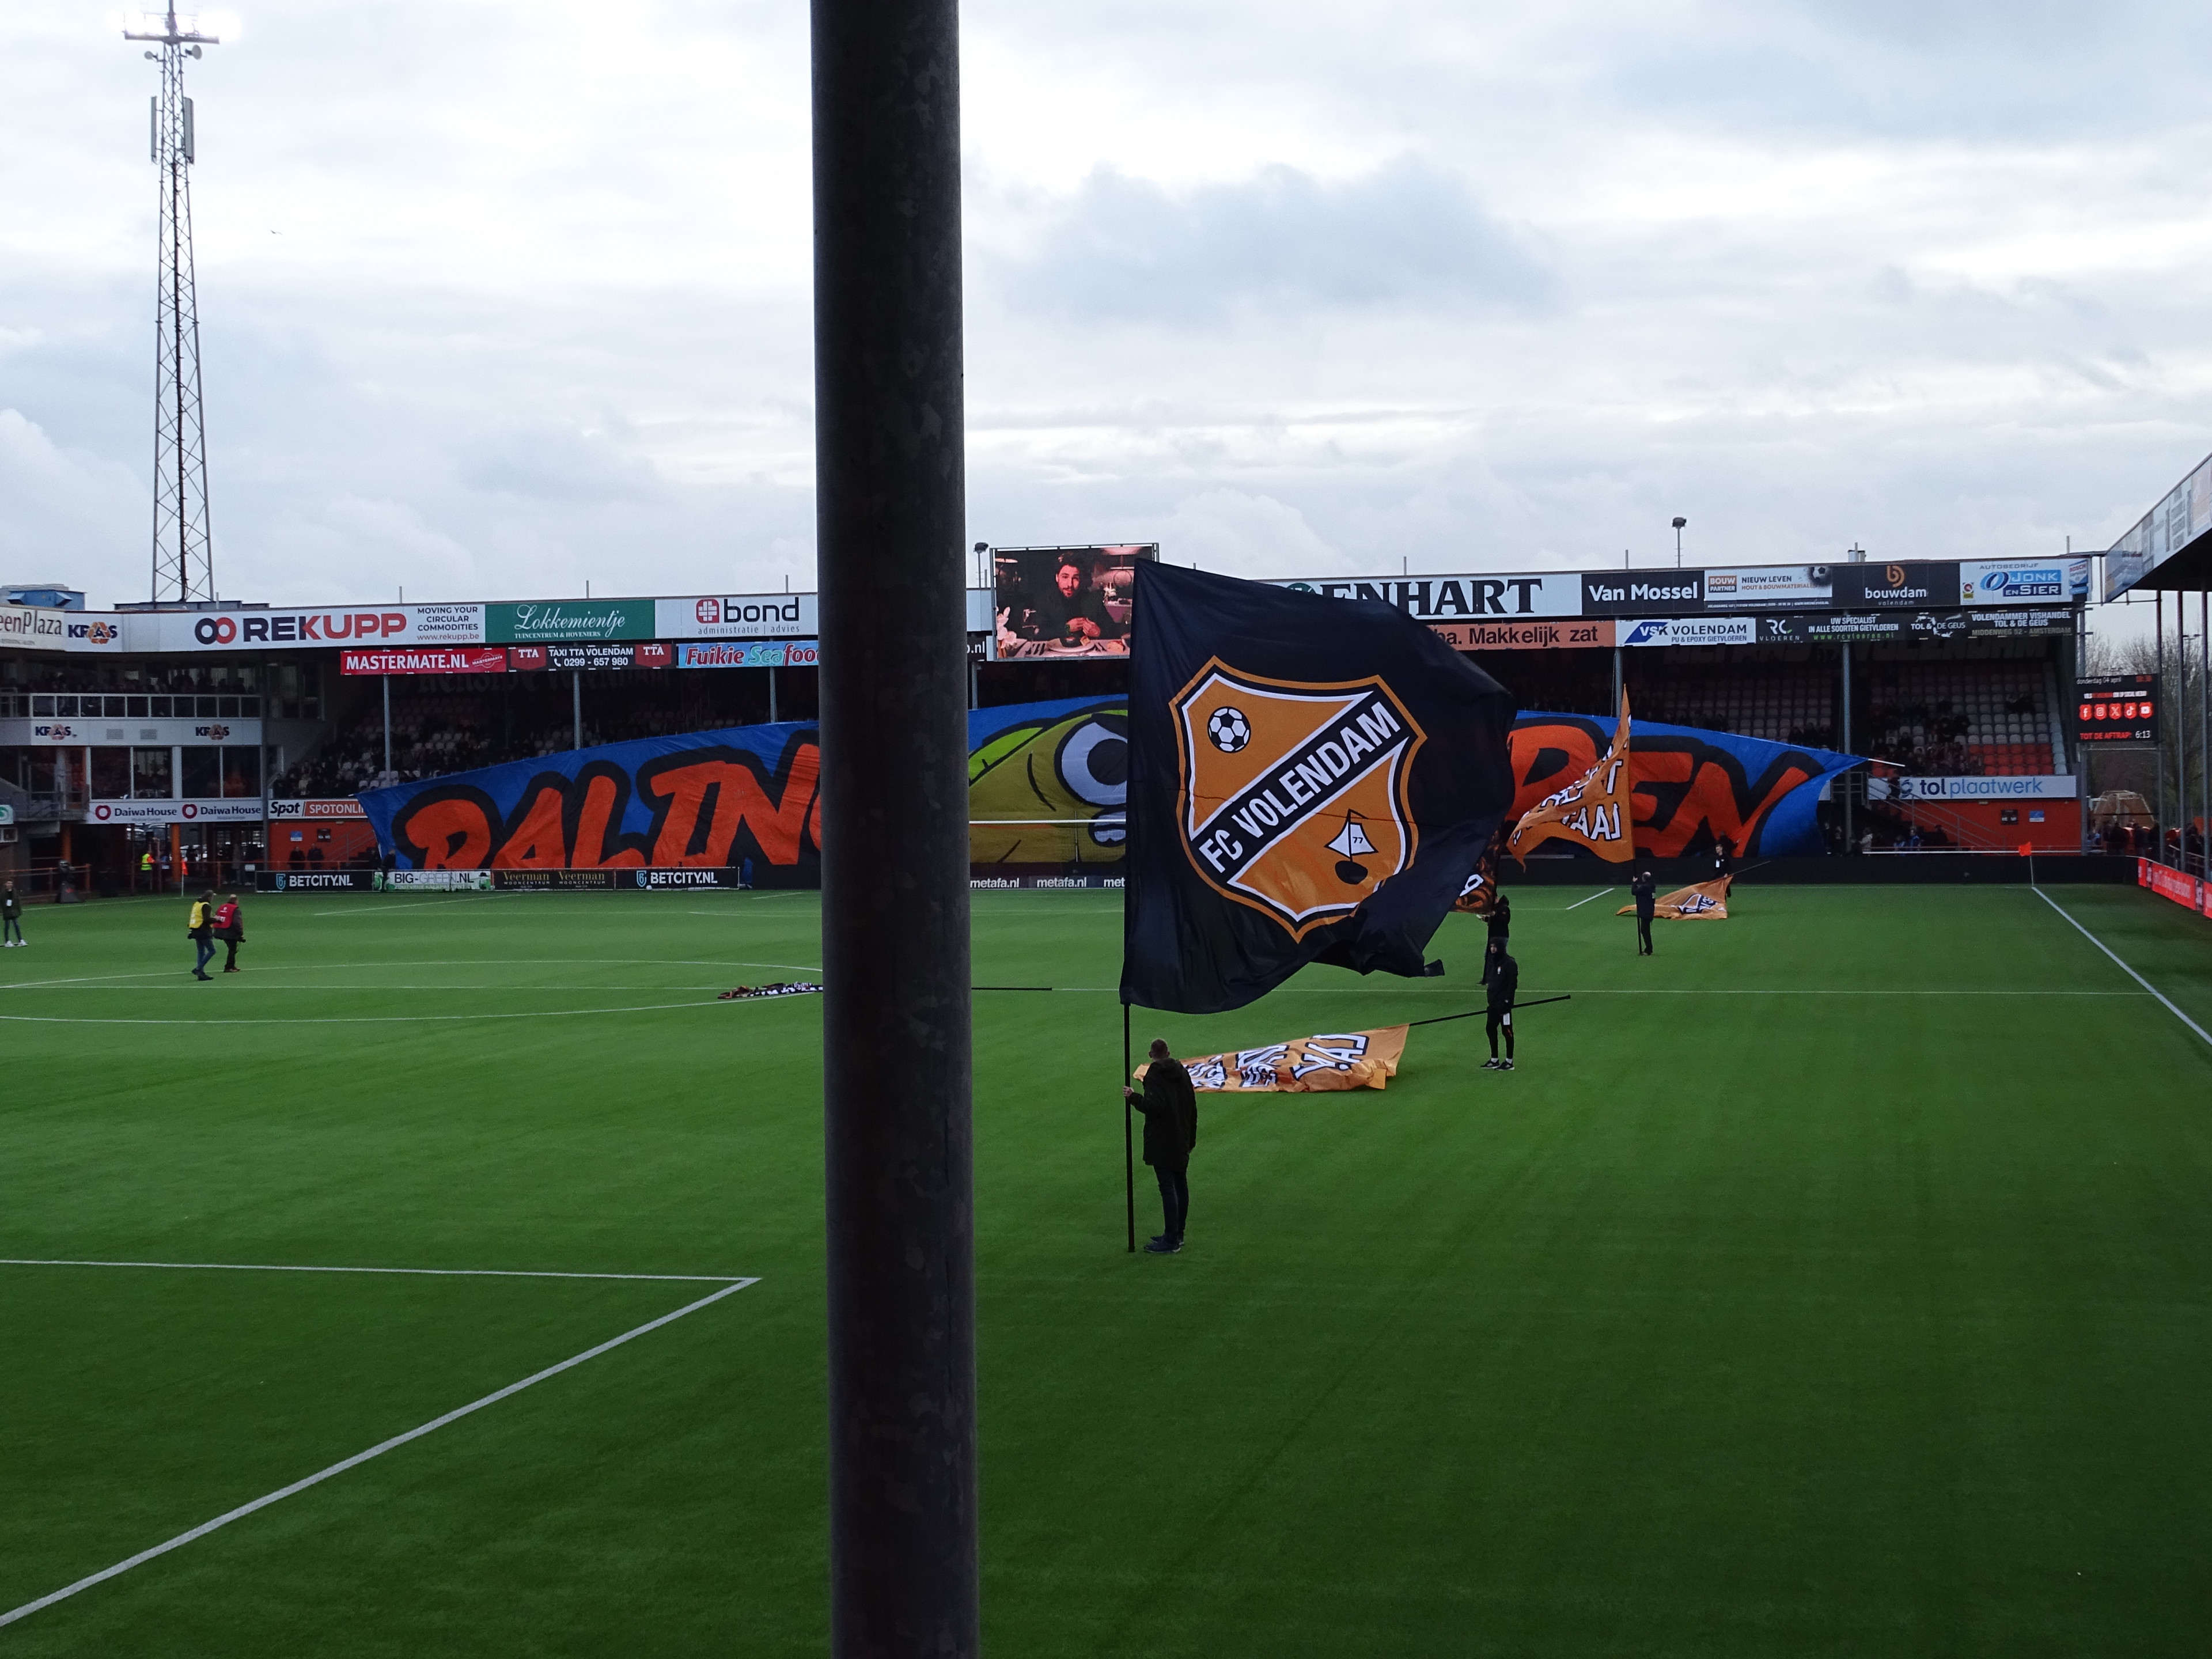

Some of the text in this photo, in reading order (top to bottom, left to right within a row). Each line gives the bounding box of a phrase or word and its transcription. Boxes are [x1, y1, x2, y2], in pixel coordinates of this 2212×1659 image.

[1710, 577, 1736, 585] BOUW
[2011, 572, 2058, 582] JONK
[1588, 582, 1698, 601] Van Mossel
[1865, 586, 1927, 599] bouwdam
[724, 597, 799, 623] bond
[426, 615, 469, 623] CIRCULAR
[514, 604, 626, 638] Lokkemientje
[1971, 611, 2071, 621] VOLENDAMMER VISHANDEL
[68, 623, 118, 641] KRAS
[243, 613, 407, 642] REKUPP
[418, 623, 479, 632] COMMODITIES
[698, 624, 800, 635] administratie advies
[1639, 625, 1668, 637] VSK
[1671, 624, 1747, 635] VOLENDAM
[1859, 623, 1899, 631] GIETVLOEREN
[417, 632, 479, 641] www.rekupp.be
[1469, 626, 1559, 647] Makkelijk
[1569, 626, 1599, 642] zat
[518, 649, 539, 658] TTA
[549, 647, 633, 657] TAXI TTA VOLENDAM
[643, 646, 664, 656] TTA
[685, 643, 819, 666] Fuikie Seafoo
[346, 654, 469, 671] MASTERMATE.NL
[563, 658, 585, 666] 0299
[593, 657, 609, 666] 657
[612, 657, 628, 666] 980
[35, 725, 71, 737] KRAS
[196, 725, 230, 737] KRAS
[2135, 730, 2151, 738] 6:13
[1198, 701, 1400, 873] FC VOLENDAM
[1920, 779, 2043, 798] tol plaatwerk
[114, 808, 177, 816] Daiwa House
[200, 806, 261, 815] Daiwa House
[270, 801, 300, 817] Spot
[1352, 836, 1364, 844] 77
[289, 874, 353, 887] BETCITY.NL
[394, 873, 475, 884] BIG-GREEN.NL
[503, 872, 550, 881] Veerman
[558, 871, 605, 880] Veerman
[650, 872, 718, 884] BETCITY.NL
[970, 877, 1020, 888] metafa.nl
[1037, 877, 1087, 888] metafa.nl
